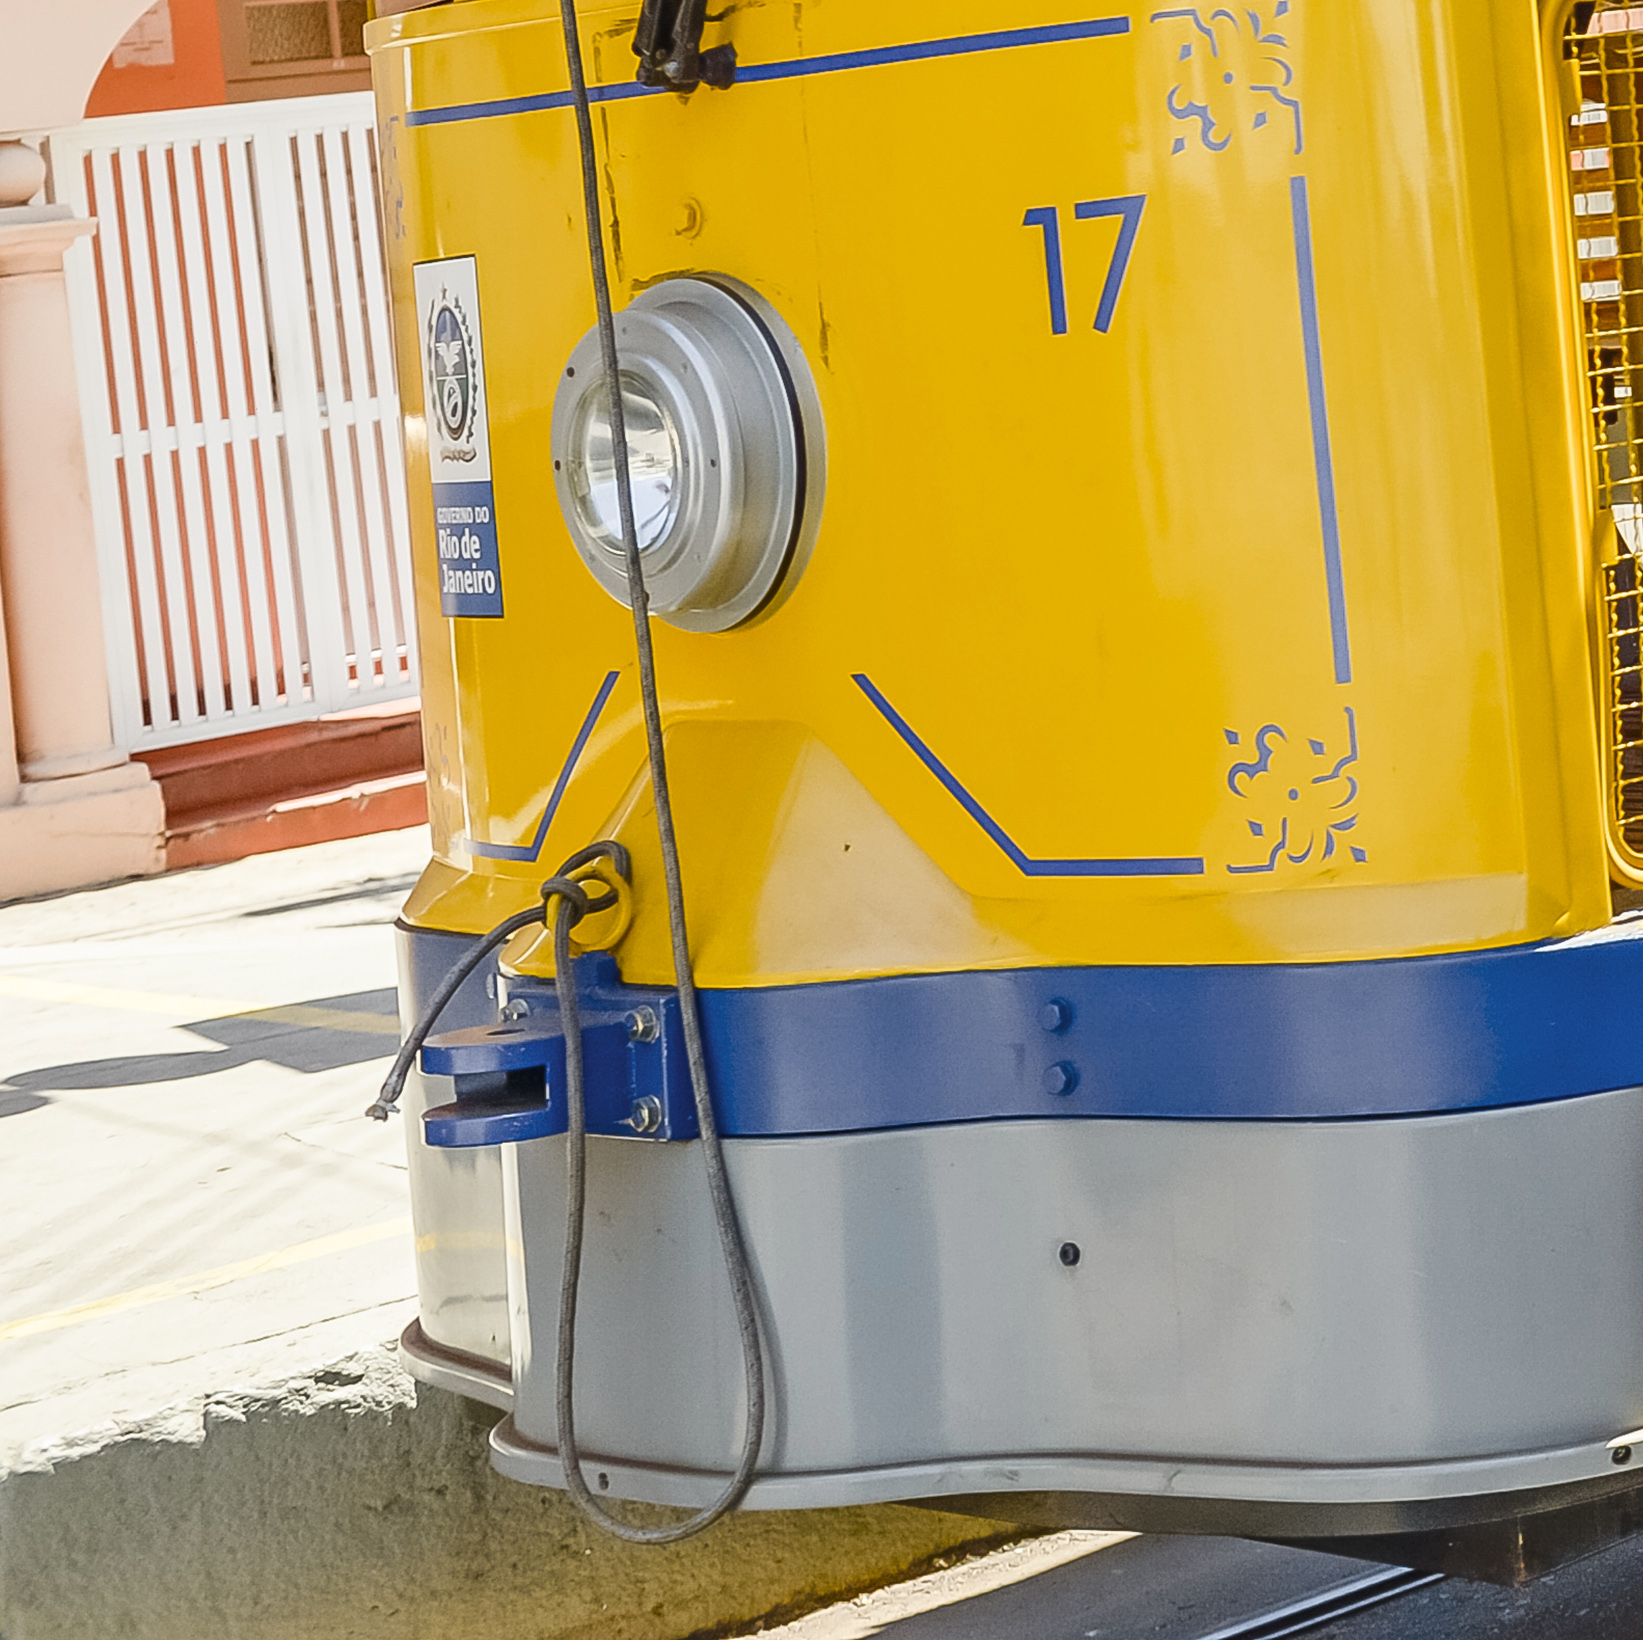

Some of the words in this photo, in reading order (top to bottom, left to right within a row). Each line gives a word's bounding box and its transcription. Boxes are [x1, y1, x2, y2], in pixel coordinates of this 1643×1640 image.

[1022, 193, 1148, 335] 17
[474, 506, 490, 524] DO
[438, 527, 460, 560] Rio
[461, 527, 481, 560] de
[442, 562, 496, 595] Janeiro
